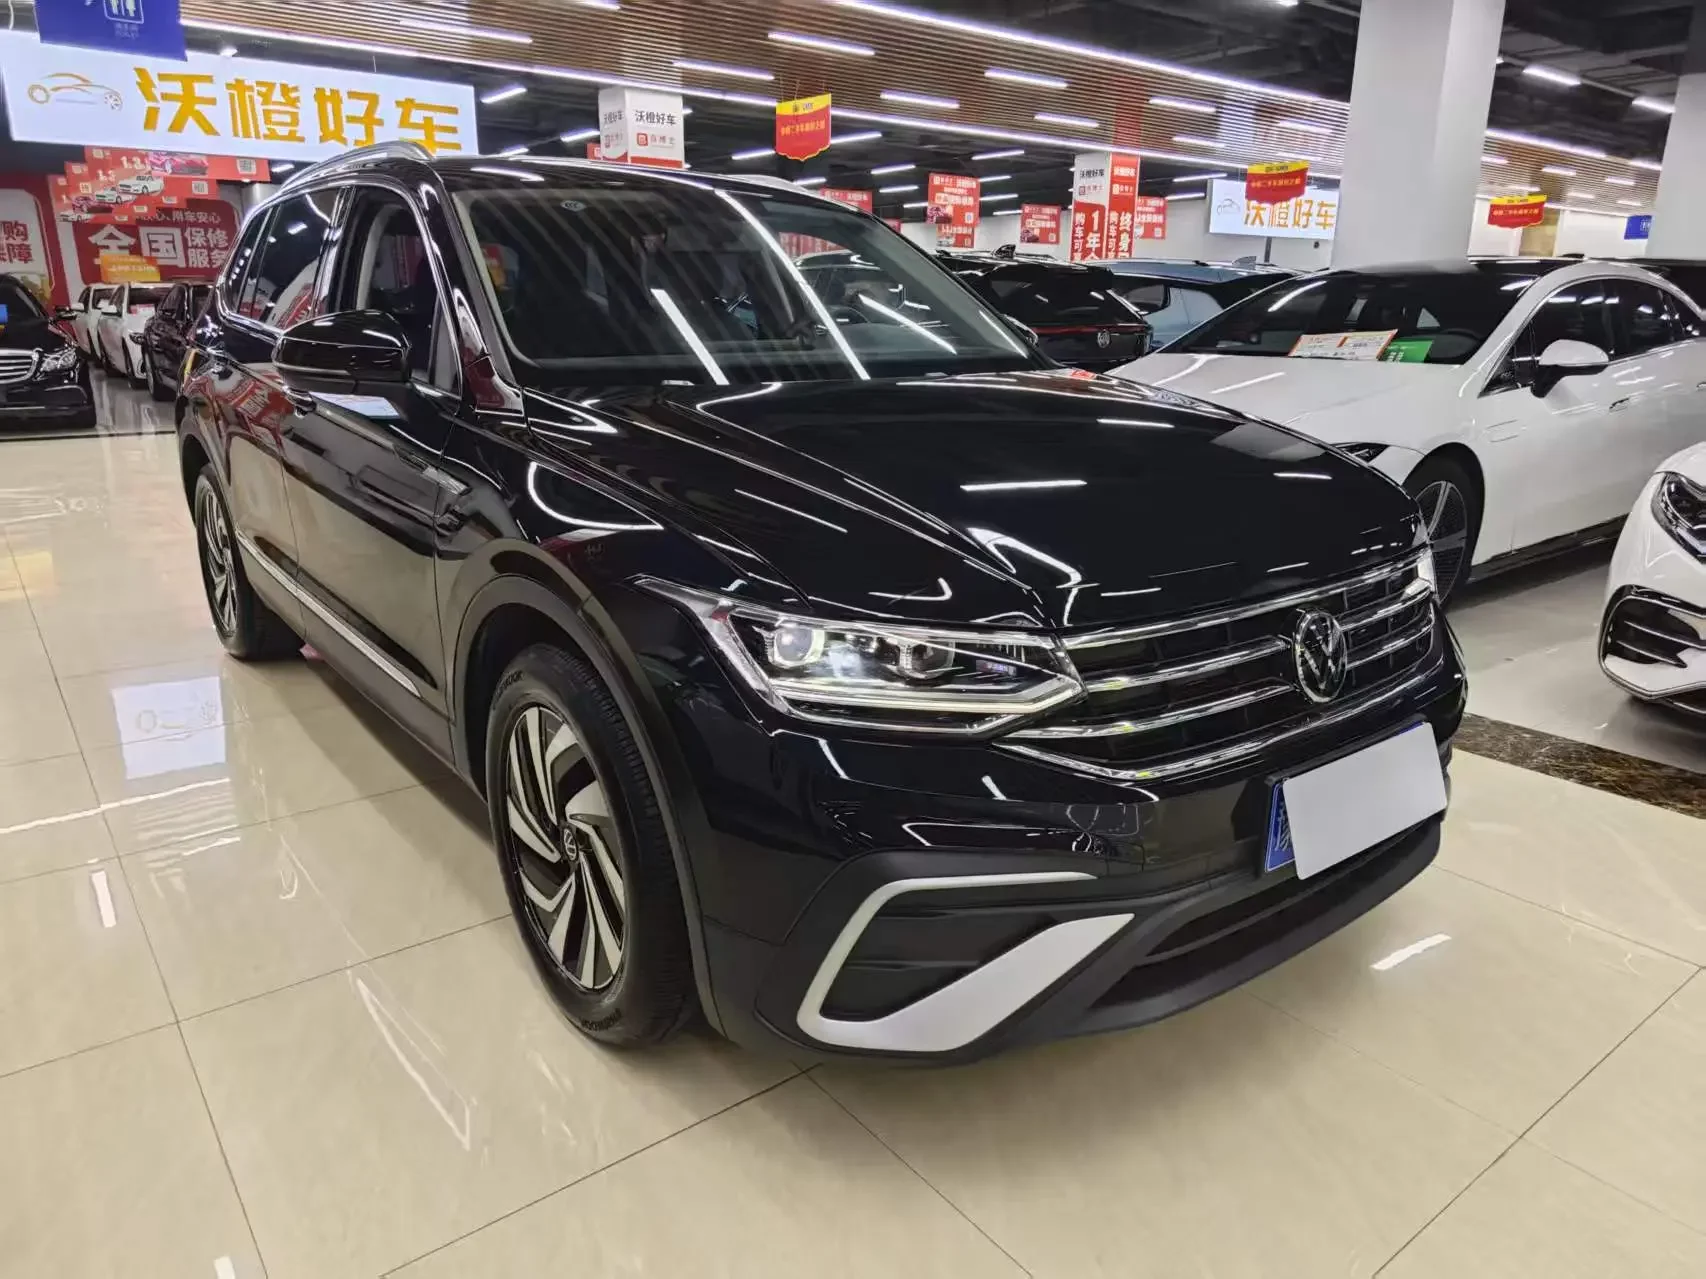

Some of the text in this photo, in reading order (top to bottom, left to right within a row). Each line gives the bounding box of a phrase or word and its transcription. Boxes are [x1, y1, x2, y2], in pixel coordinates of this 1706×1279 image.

[134, 67, 463, 153] 沃橙好车
[635, 110, 677, 126] 沃橙好车
[1244, 199, 1337, 230] 沃橙好车
[184, 227, 229, 248] 保修
